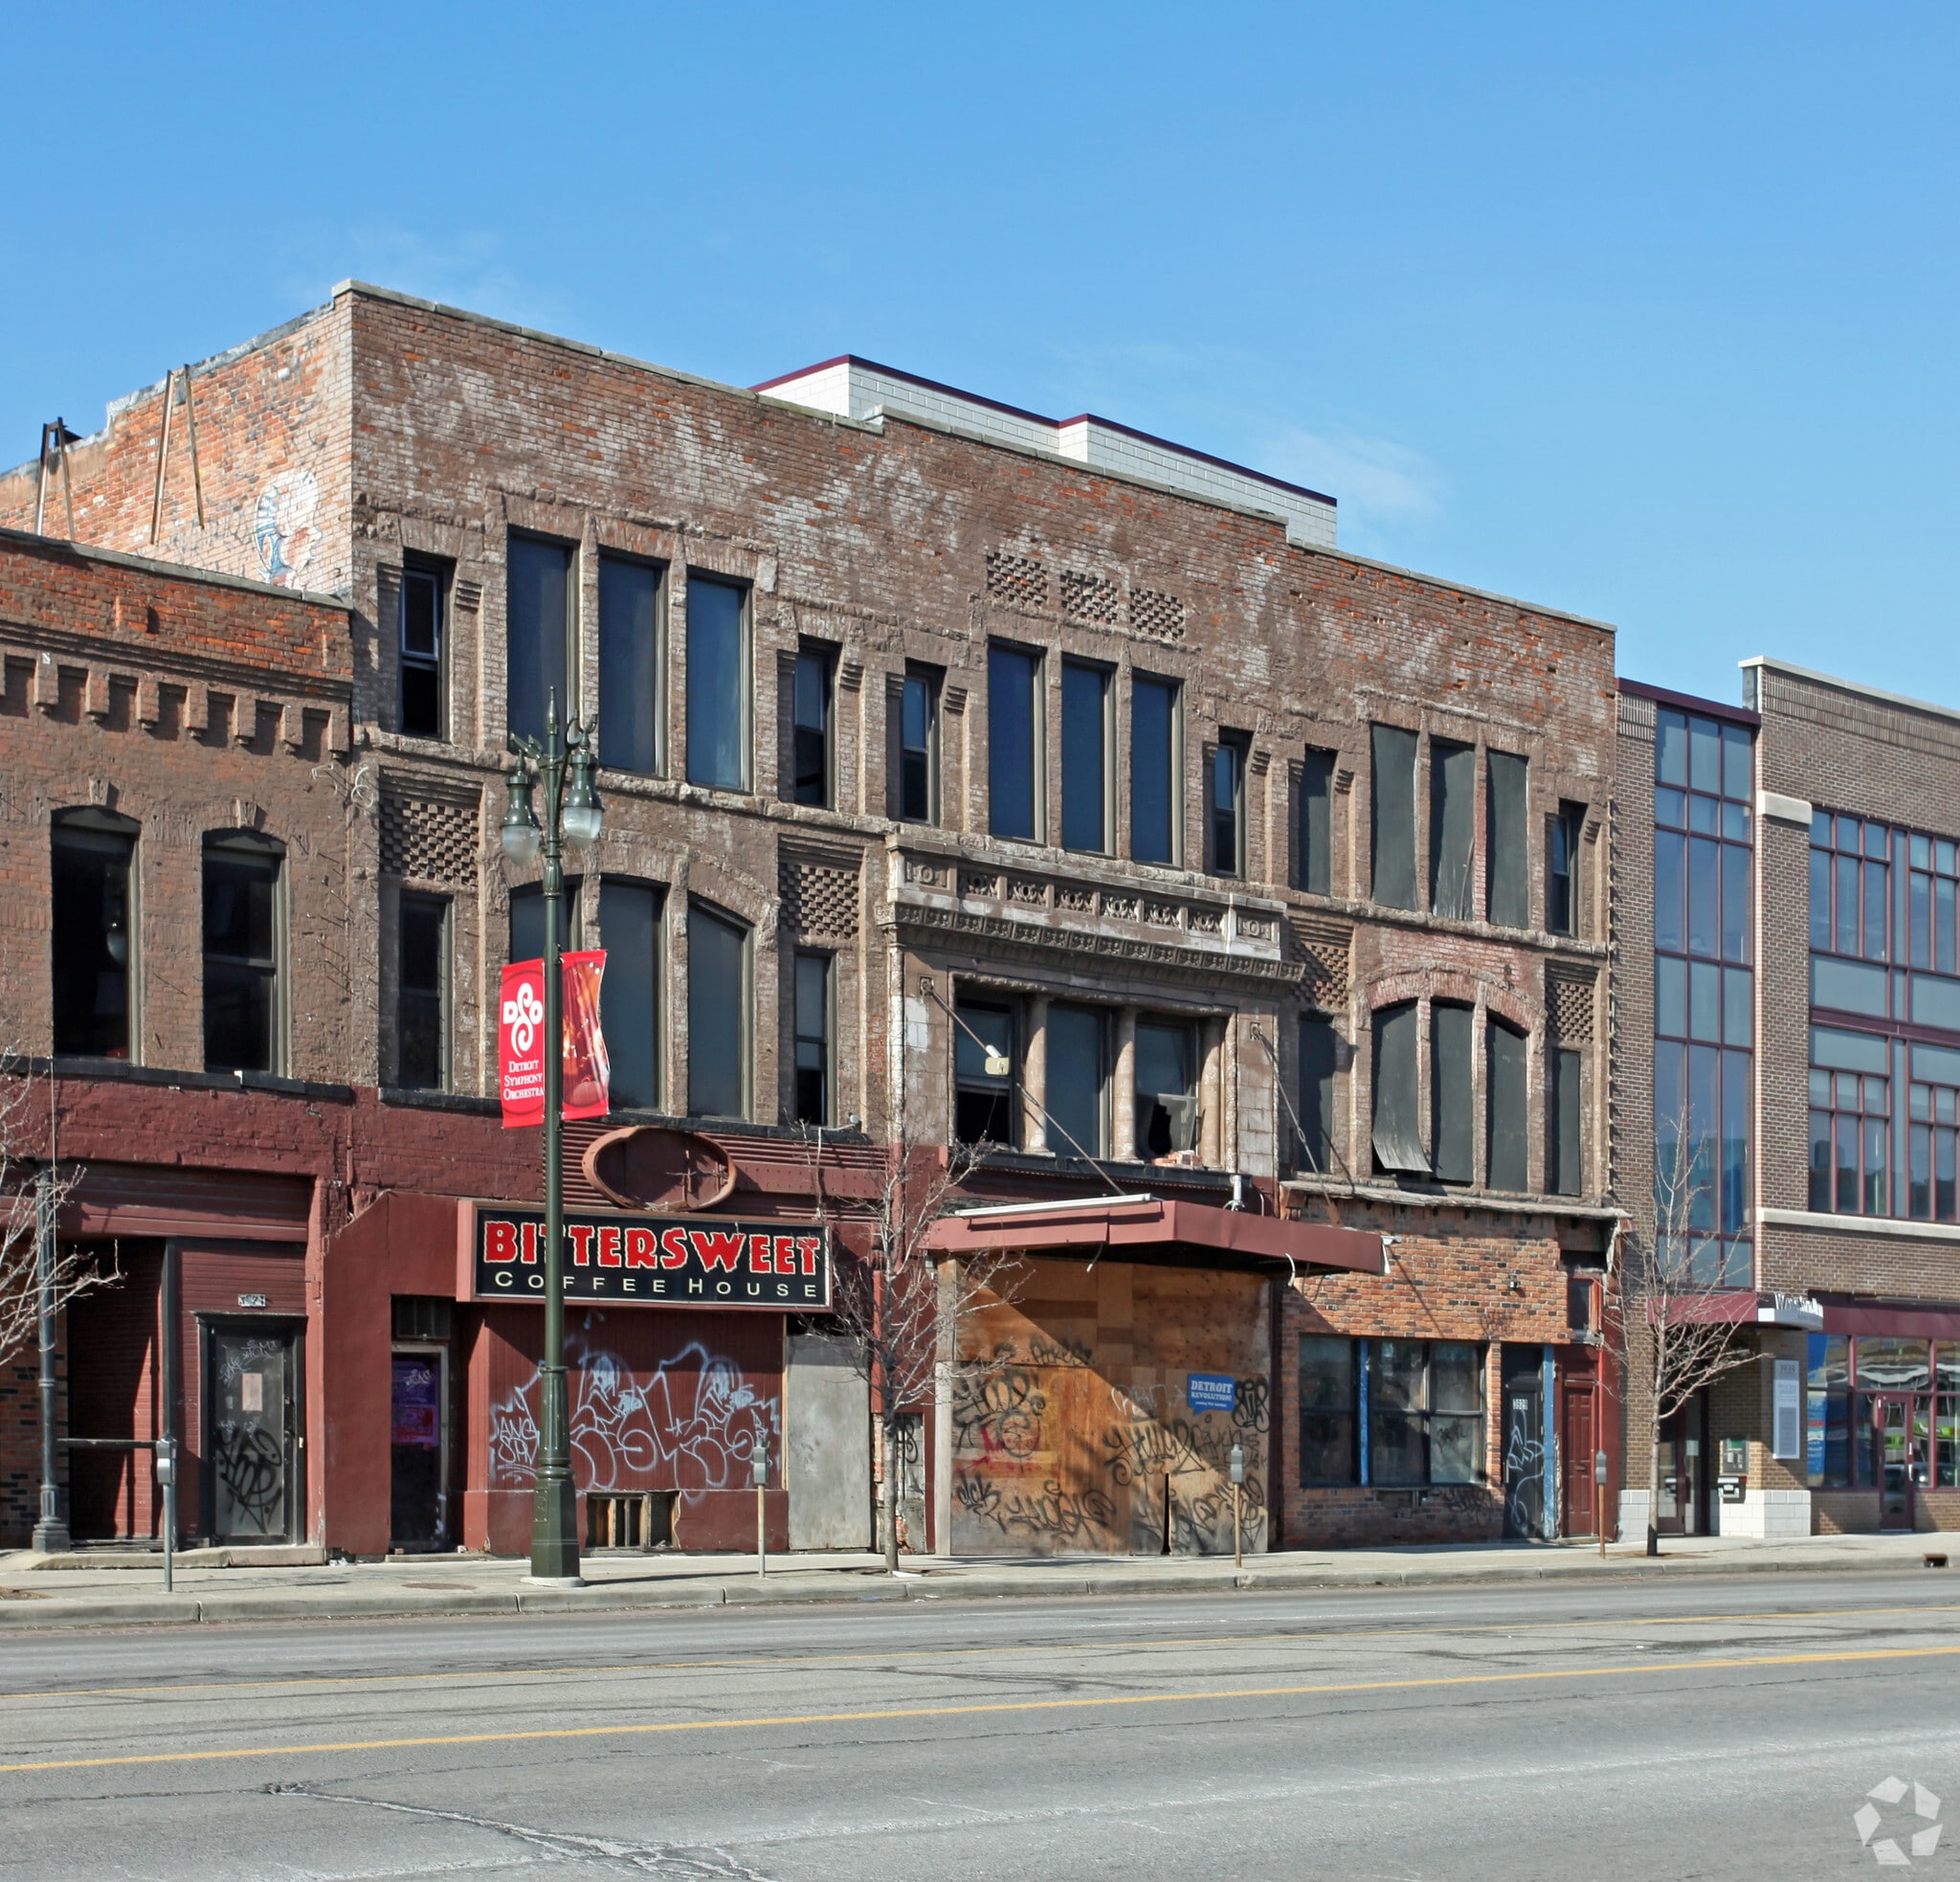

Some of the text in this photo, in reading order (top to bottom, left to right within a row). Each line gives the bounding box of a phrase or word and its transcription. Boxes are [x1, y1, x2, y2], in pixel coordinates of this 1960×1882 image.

[494, 1271, 817, 1298] COFFEE HOUSE
[1191, 1379, 1233, 1394] DETROIT
